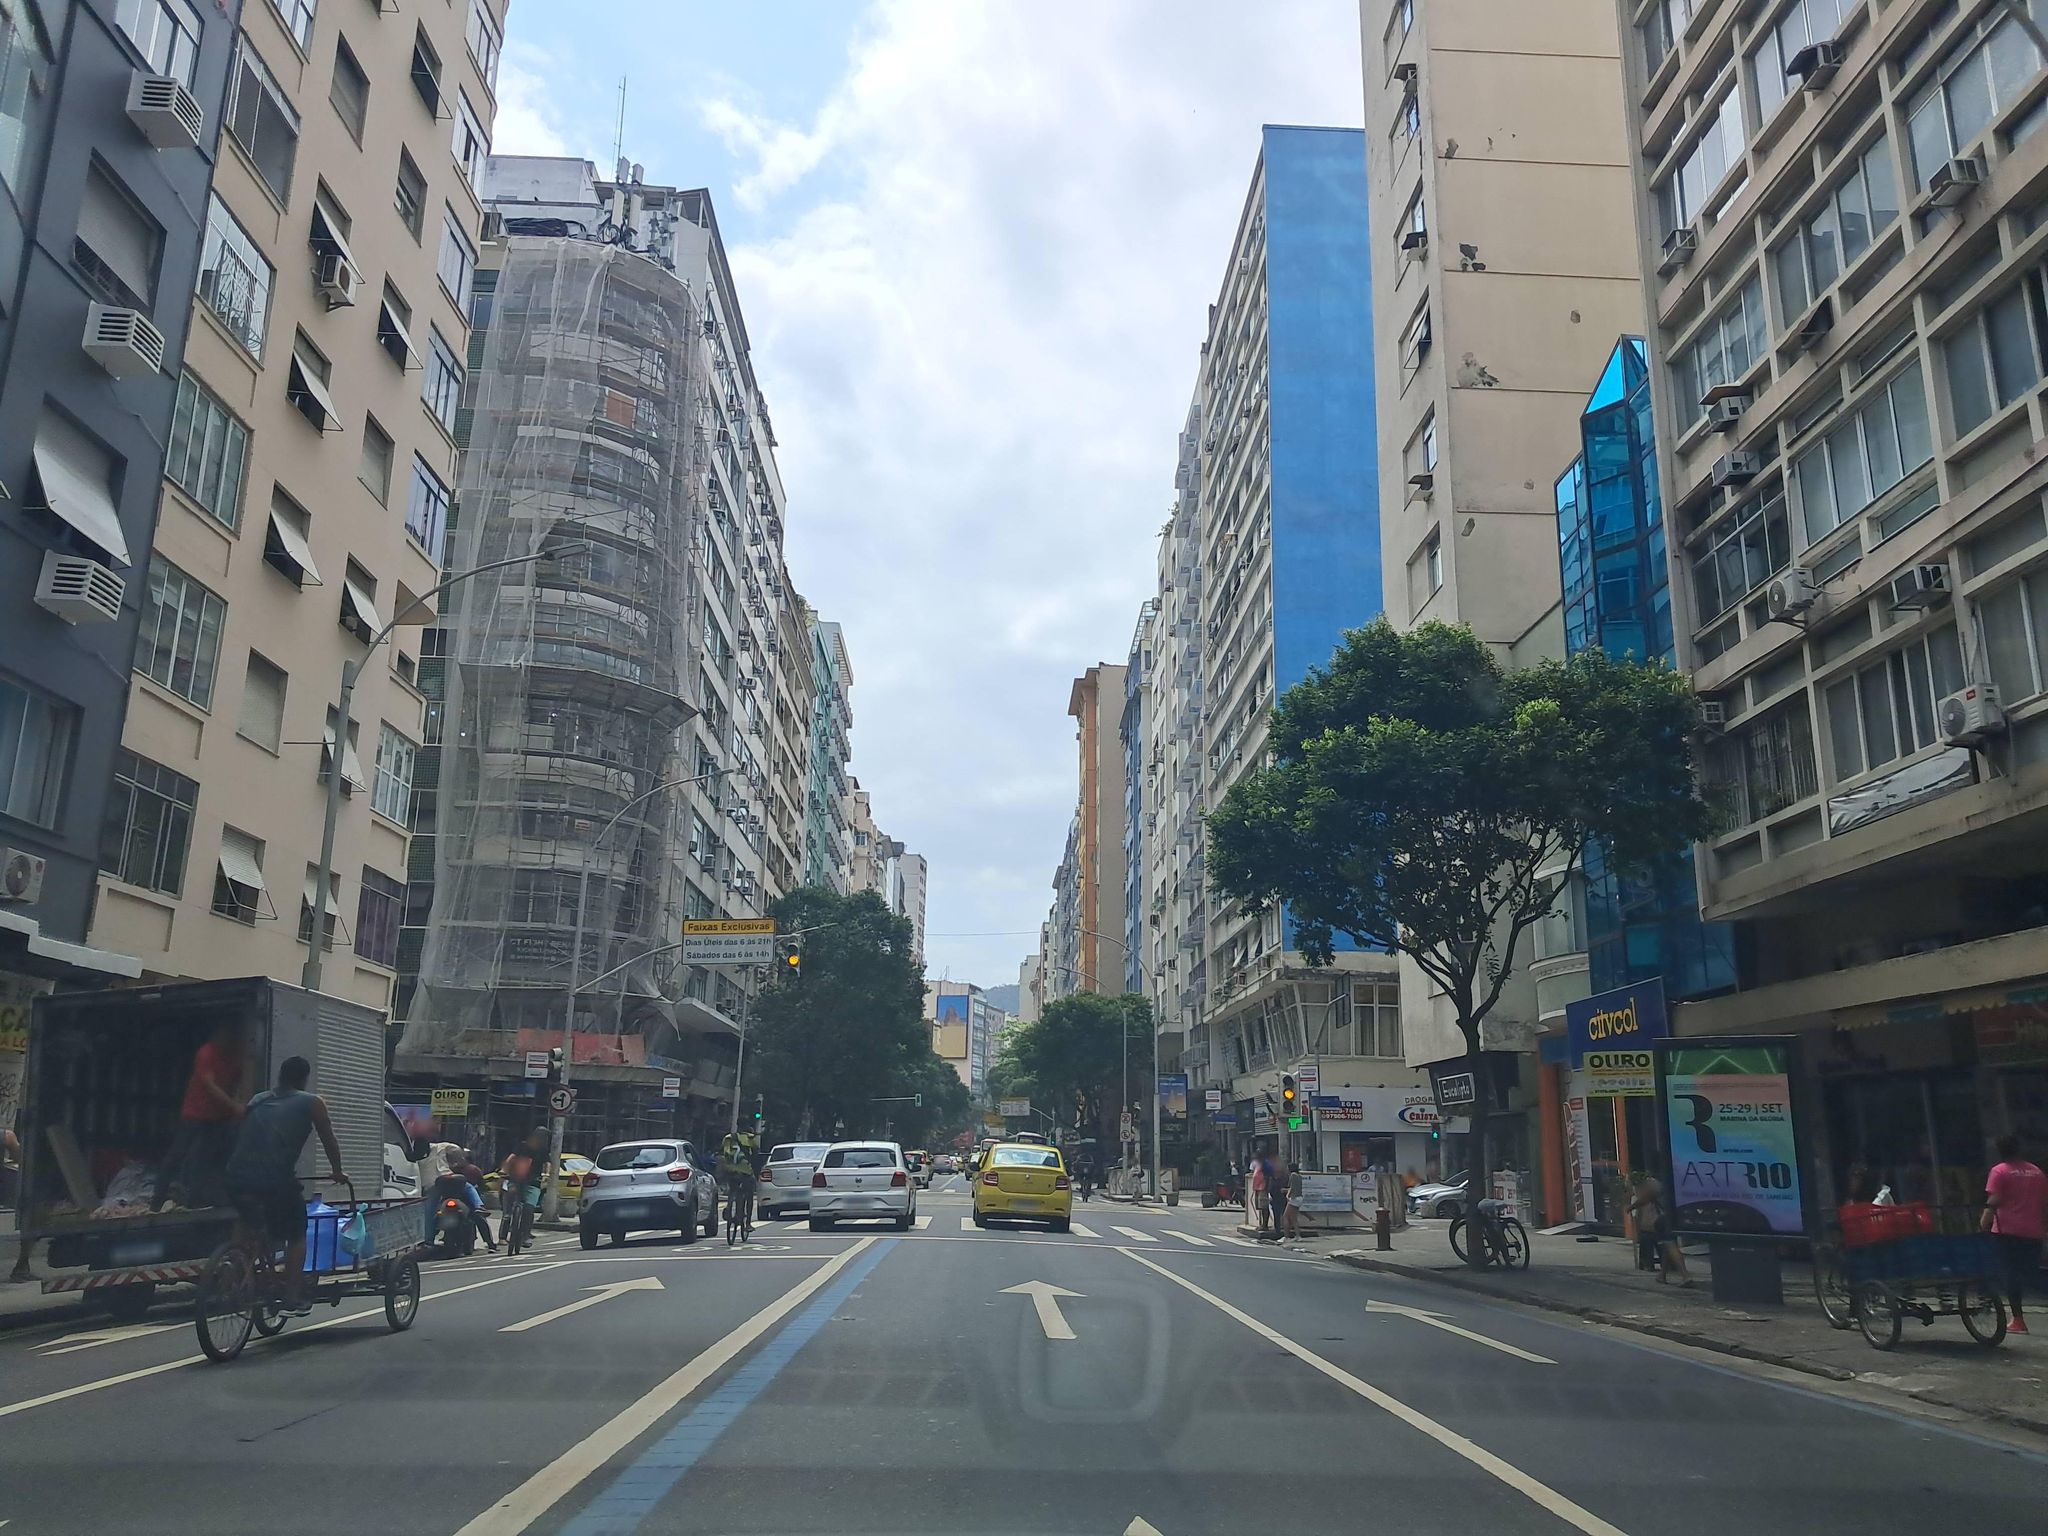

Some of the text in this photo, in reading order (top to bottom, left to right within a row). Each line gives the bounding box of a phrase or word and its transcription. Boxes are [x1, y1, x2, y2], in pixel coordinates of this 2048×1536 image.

[687, 922, 770, 932] Faixas Exclusivas
[686, 951, 721, 959] Sábados
[722, 951, 736, 959] das
[1589, 1053, 1650, 1068] OURO
[1442, 1078, 1470, 1099] Eucalipto
[434, 1091, 465, 1099] OURO
[1719, 1103, 1752, 1114] 25-29
[1761, 1103, 1783, 1114] SET
[1409, 1111, 1438, 1120] CRISTA
